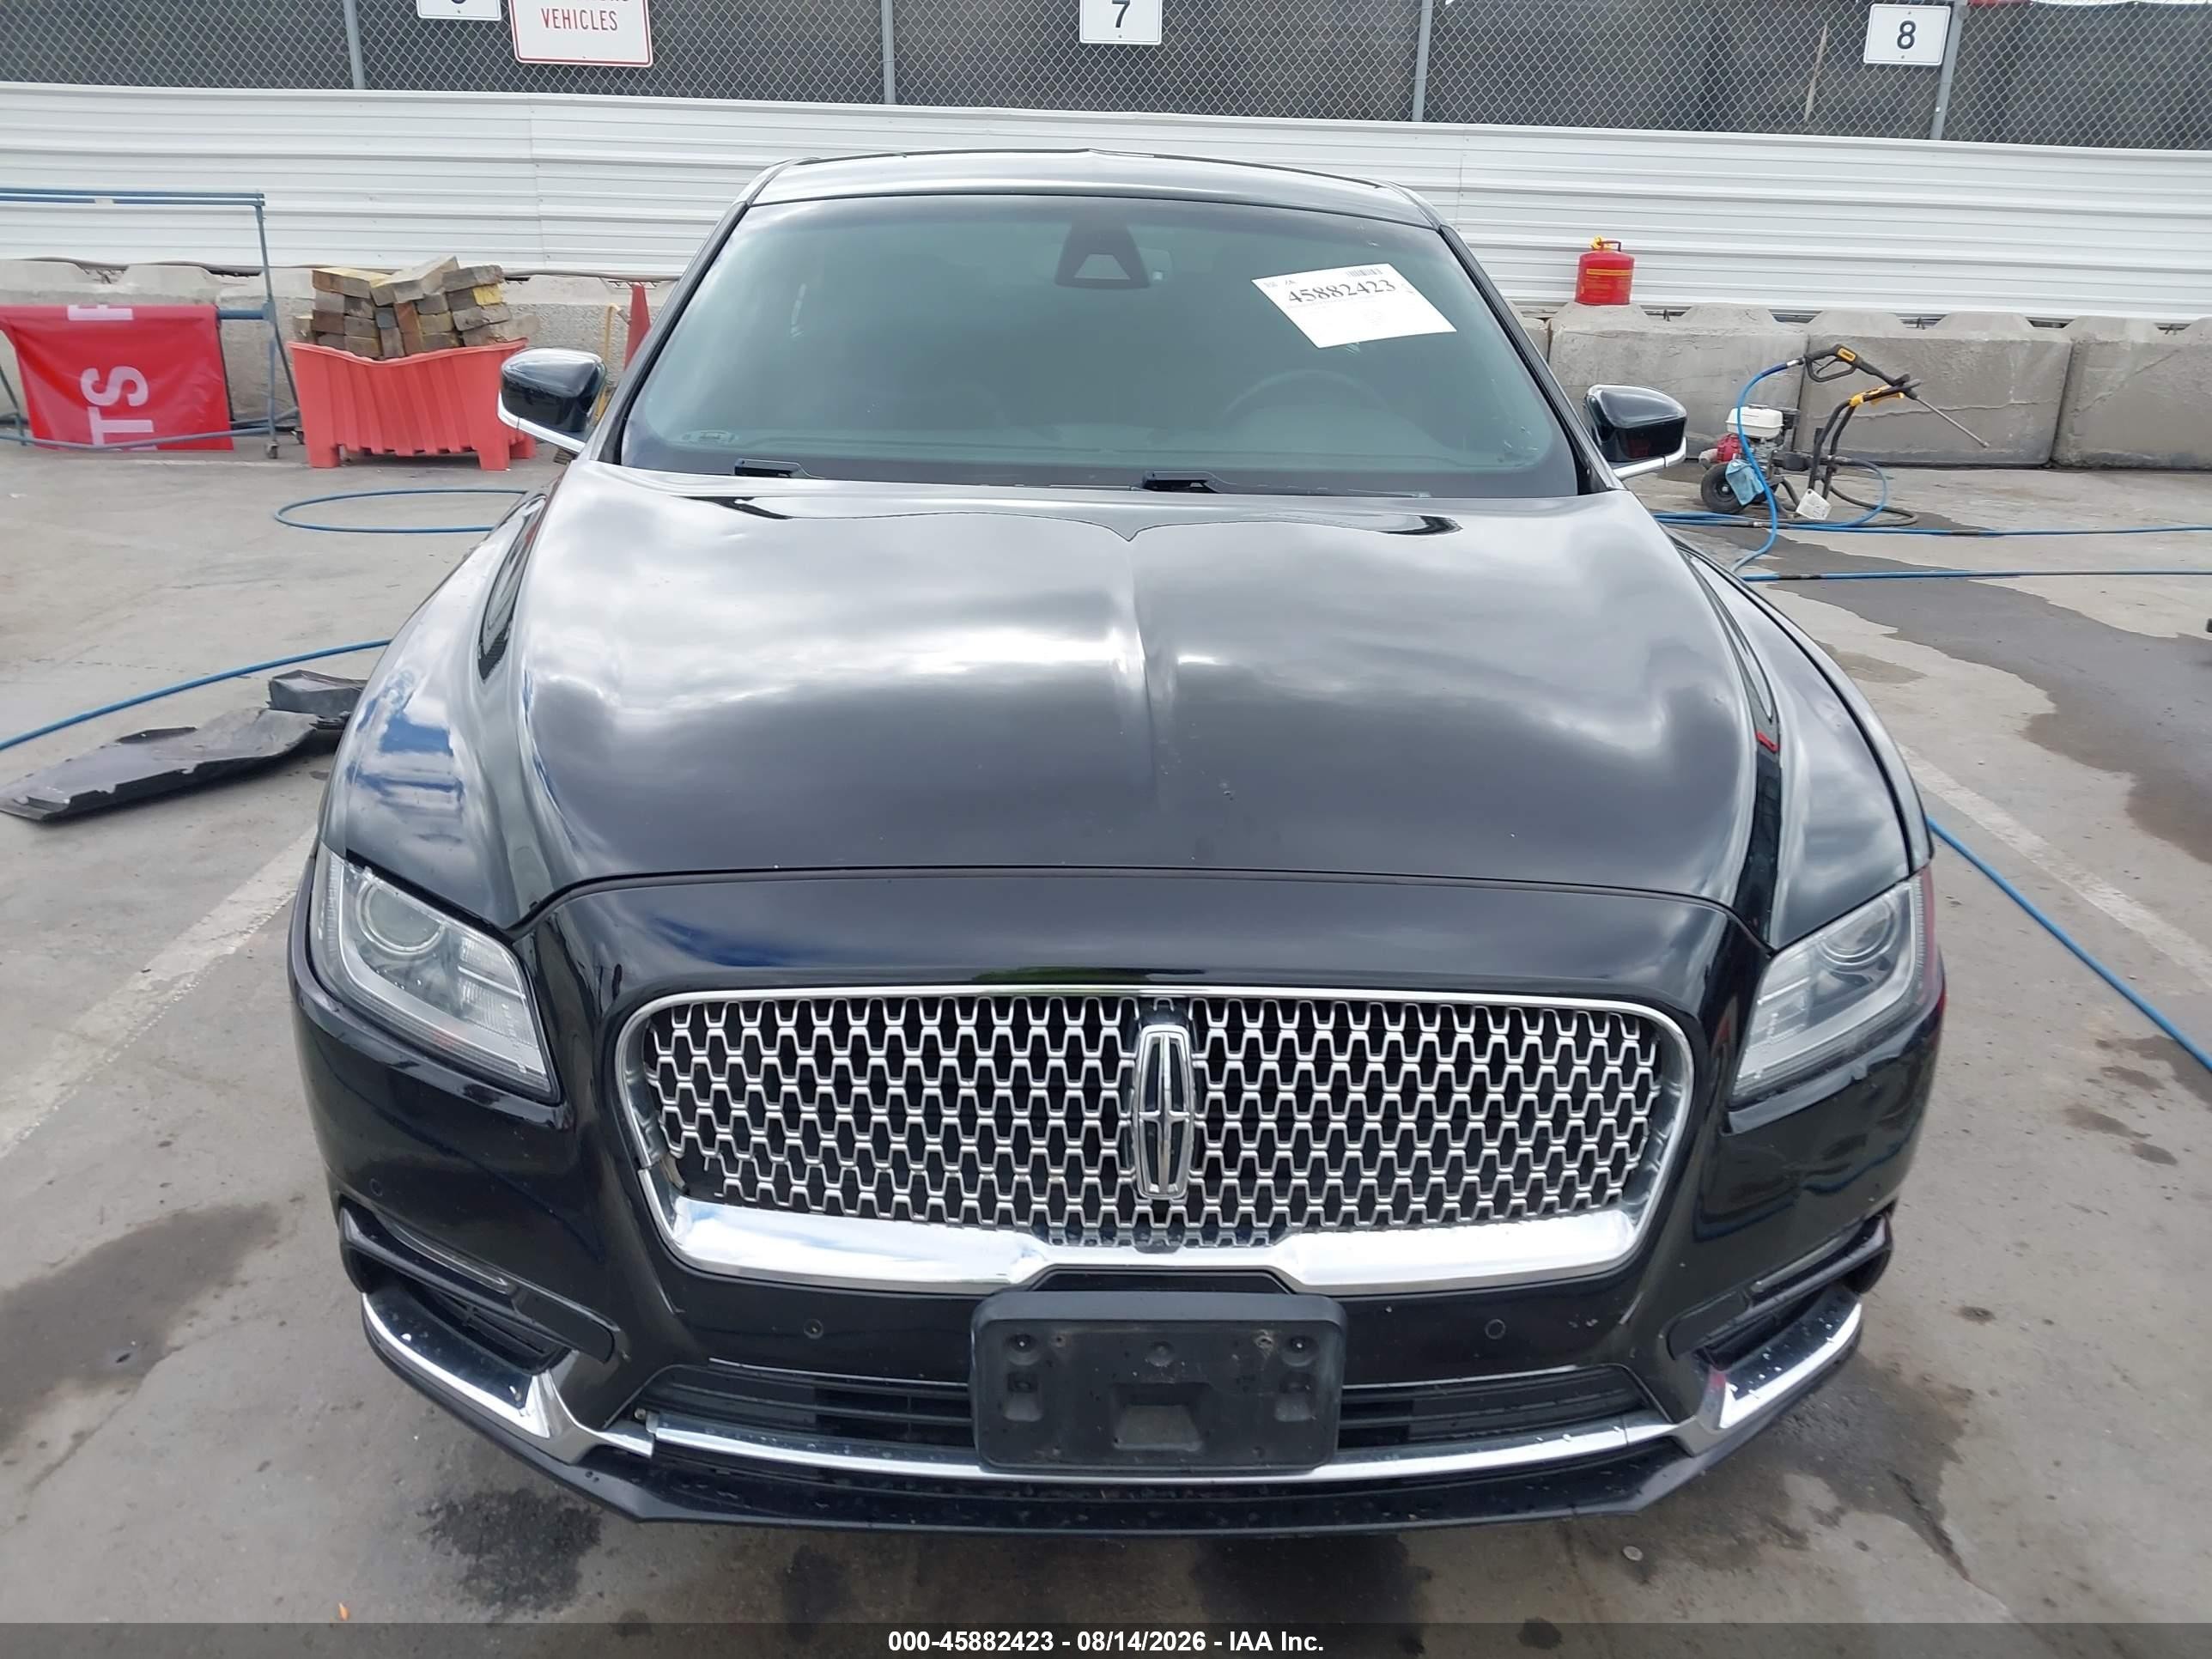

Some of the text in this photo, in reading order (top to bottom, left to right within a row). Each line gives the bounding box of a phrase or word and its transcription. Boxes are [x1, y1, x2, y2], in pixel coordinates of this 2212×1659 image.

[540, 8, 618, 31] VEHICLES
[1111, 0, 1131, 28] 7
[1896, 20, 1917, 50] 8
[1288, 279, 1397, 303] 45882423
